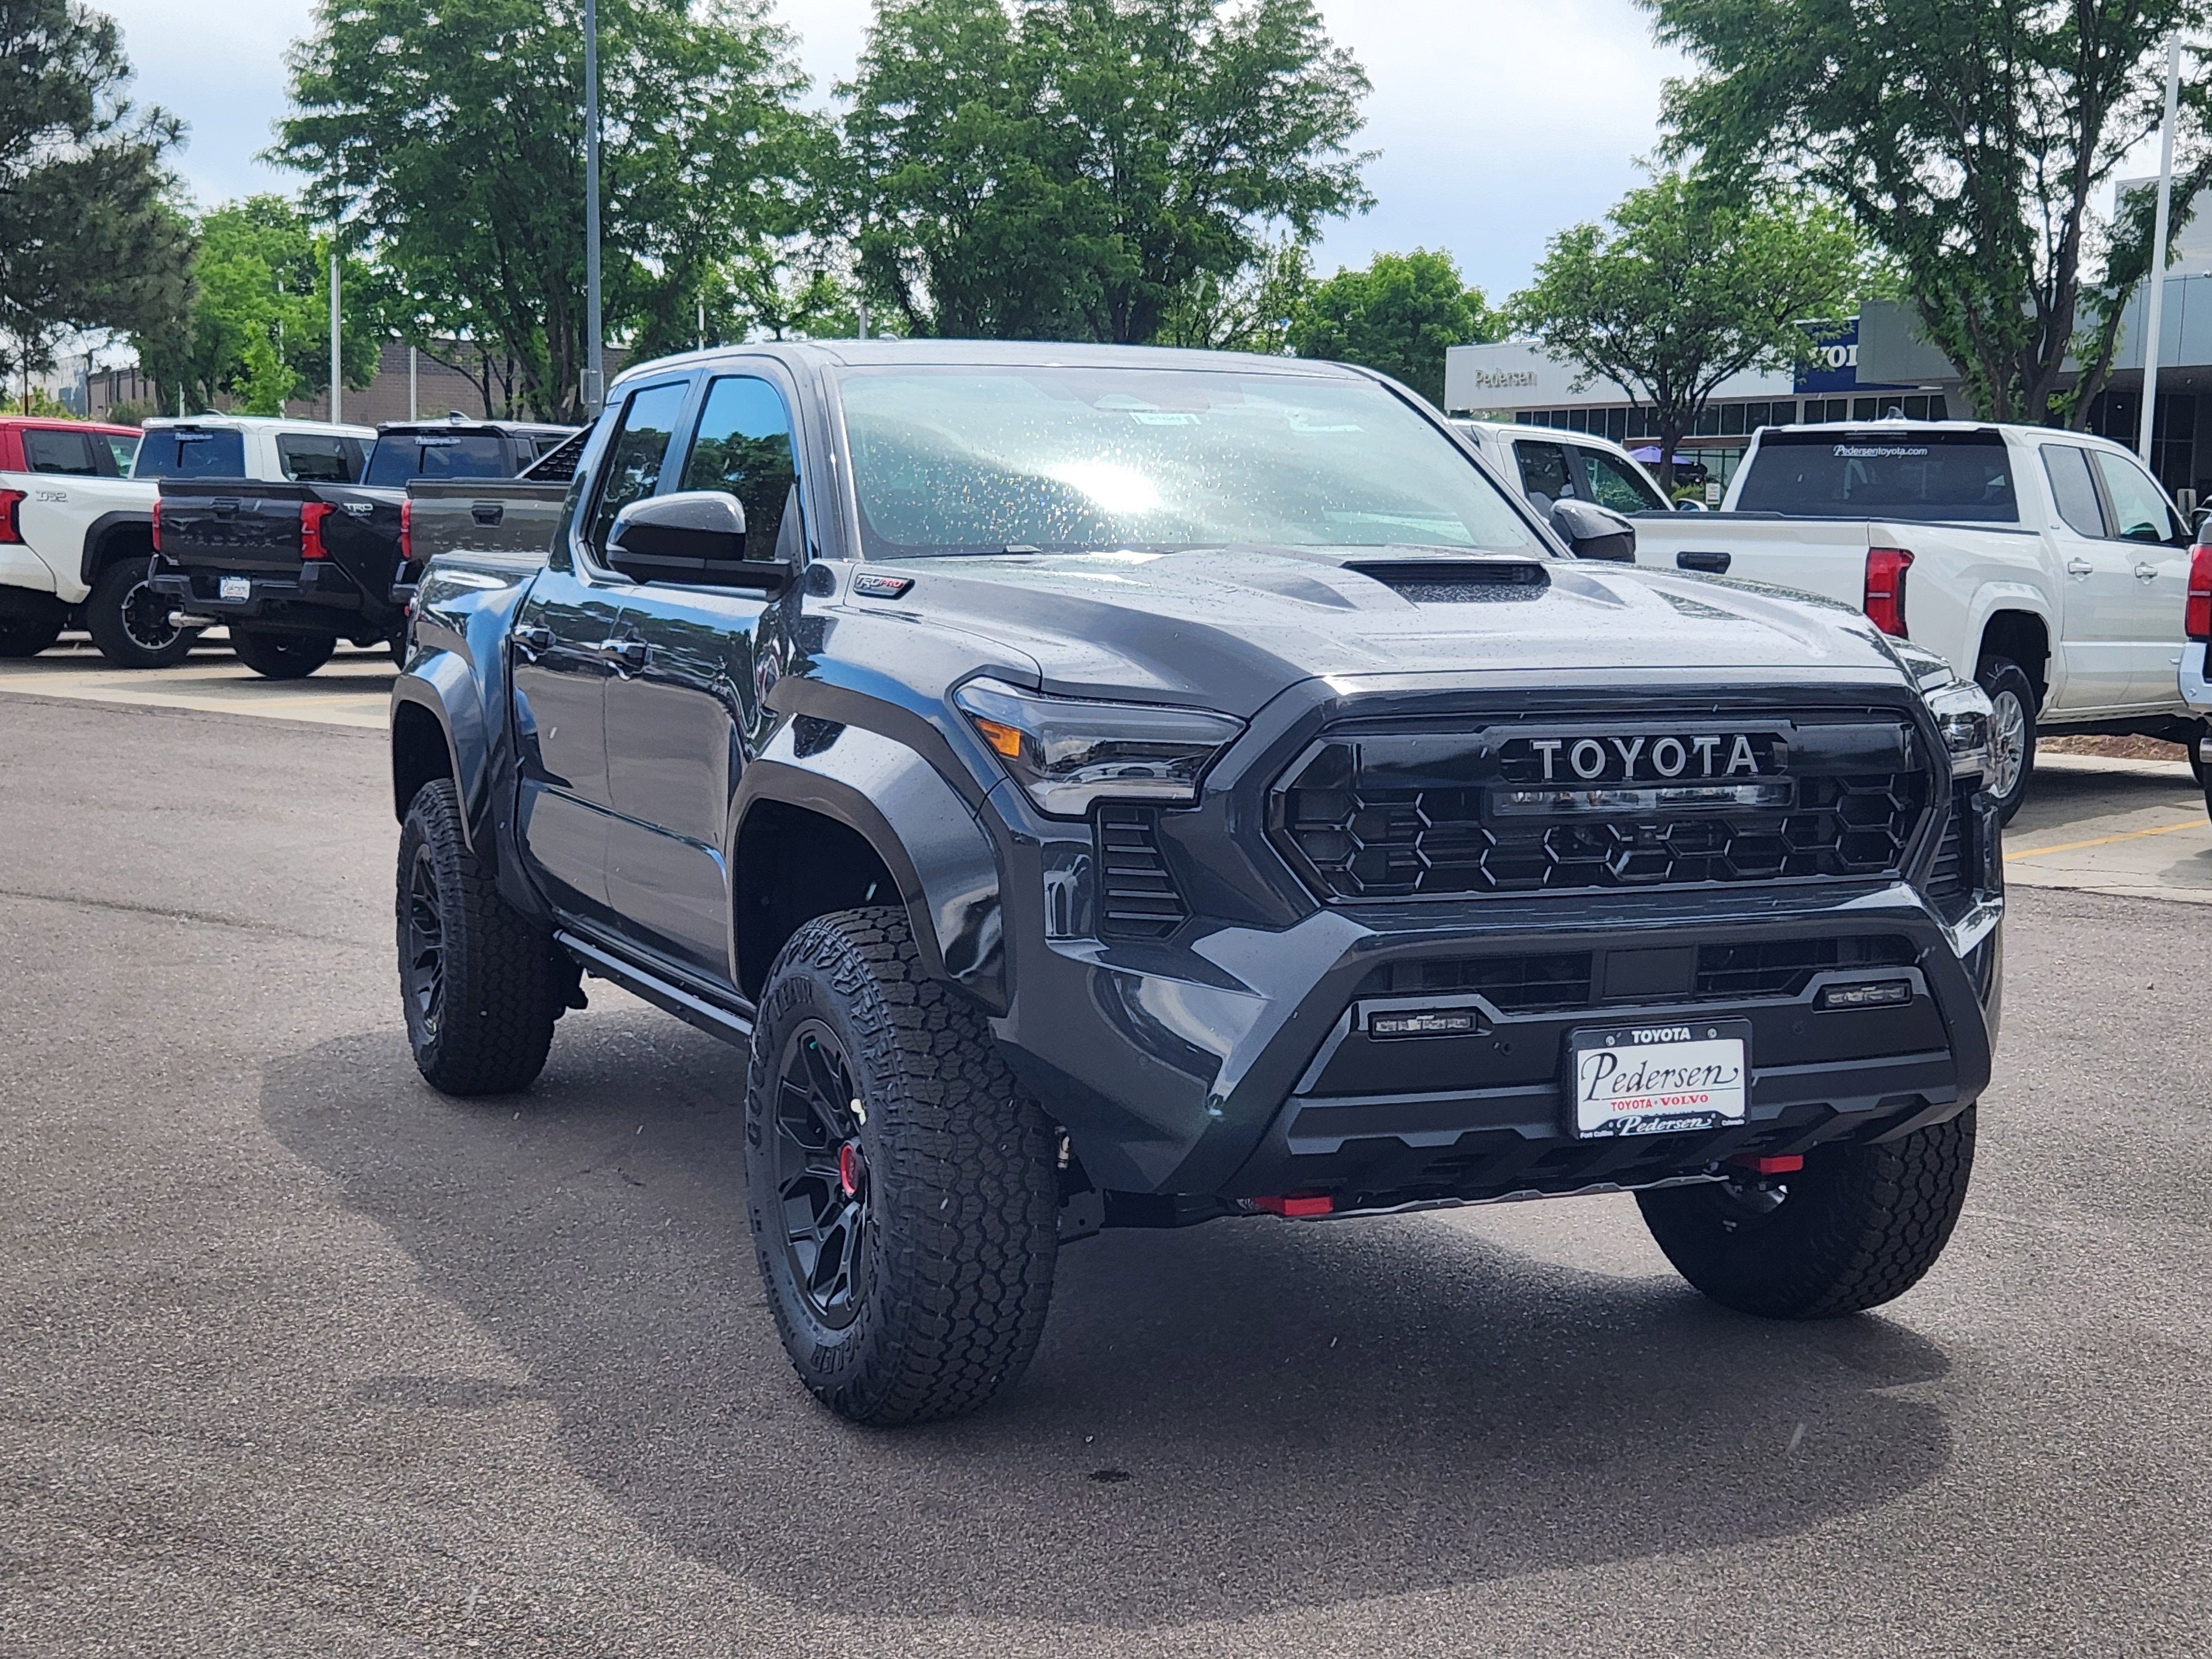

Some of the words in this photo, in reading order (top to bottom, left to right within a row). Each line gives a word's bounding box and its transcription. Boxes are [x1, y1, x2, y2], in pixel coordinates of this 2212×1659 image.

[1475, 367, 1537, 389] Pedersen
[1531, 734, 1759, 781] TOYOTA
[1631, 1027, 1692, 1044] TOYOTA
[1580, 1052, 1739, 1103] Pedersen
[1610, 1098, 1653, 1112] TOYOTA
[1660, 1094, 1709, 1107] VOLVO
[1616, 1114, 1713, 1136] Pedersen
